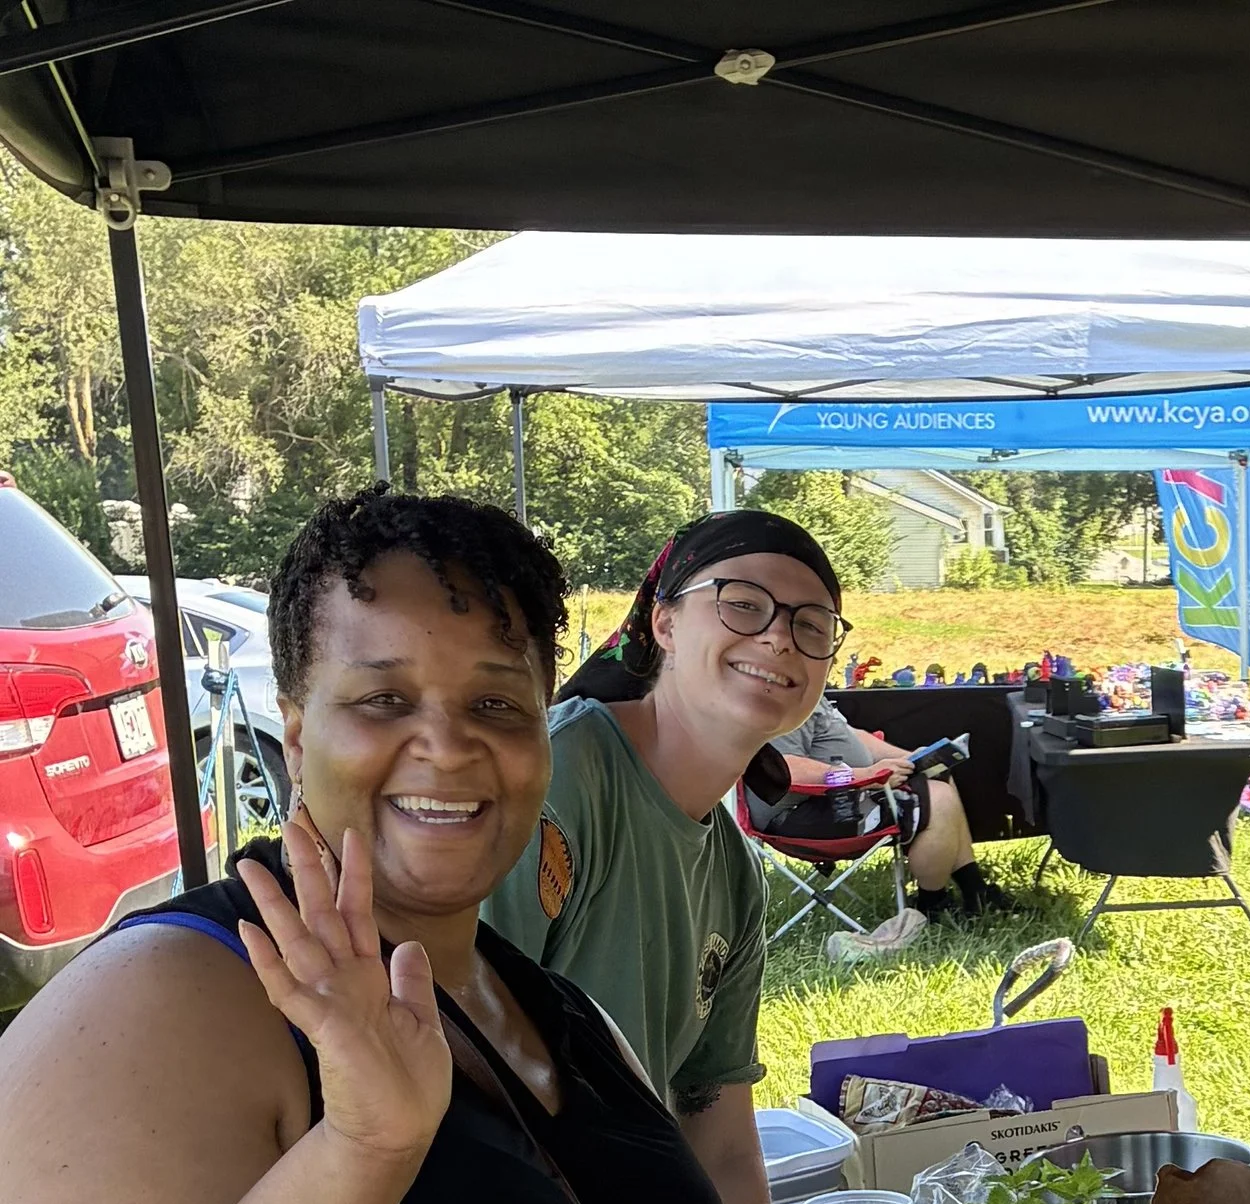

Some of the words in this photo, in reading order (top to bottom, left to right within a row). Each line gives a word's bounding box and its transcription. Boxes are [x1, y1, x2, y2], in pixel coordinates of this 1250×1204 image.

[816, 412, 889, 430] YOUNG
[893, 412, 996, 430] AUDIENCES
[991, 1122, 1059, 1140] SKOTIDAKIS
[995, 1145, 1047, 1164] GRE
